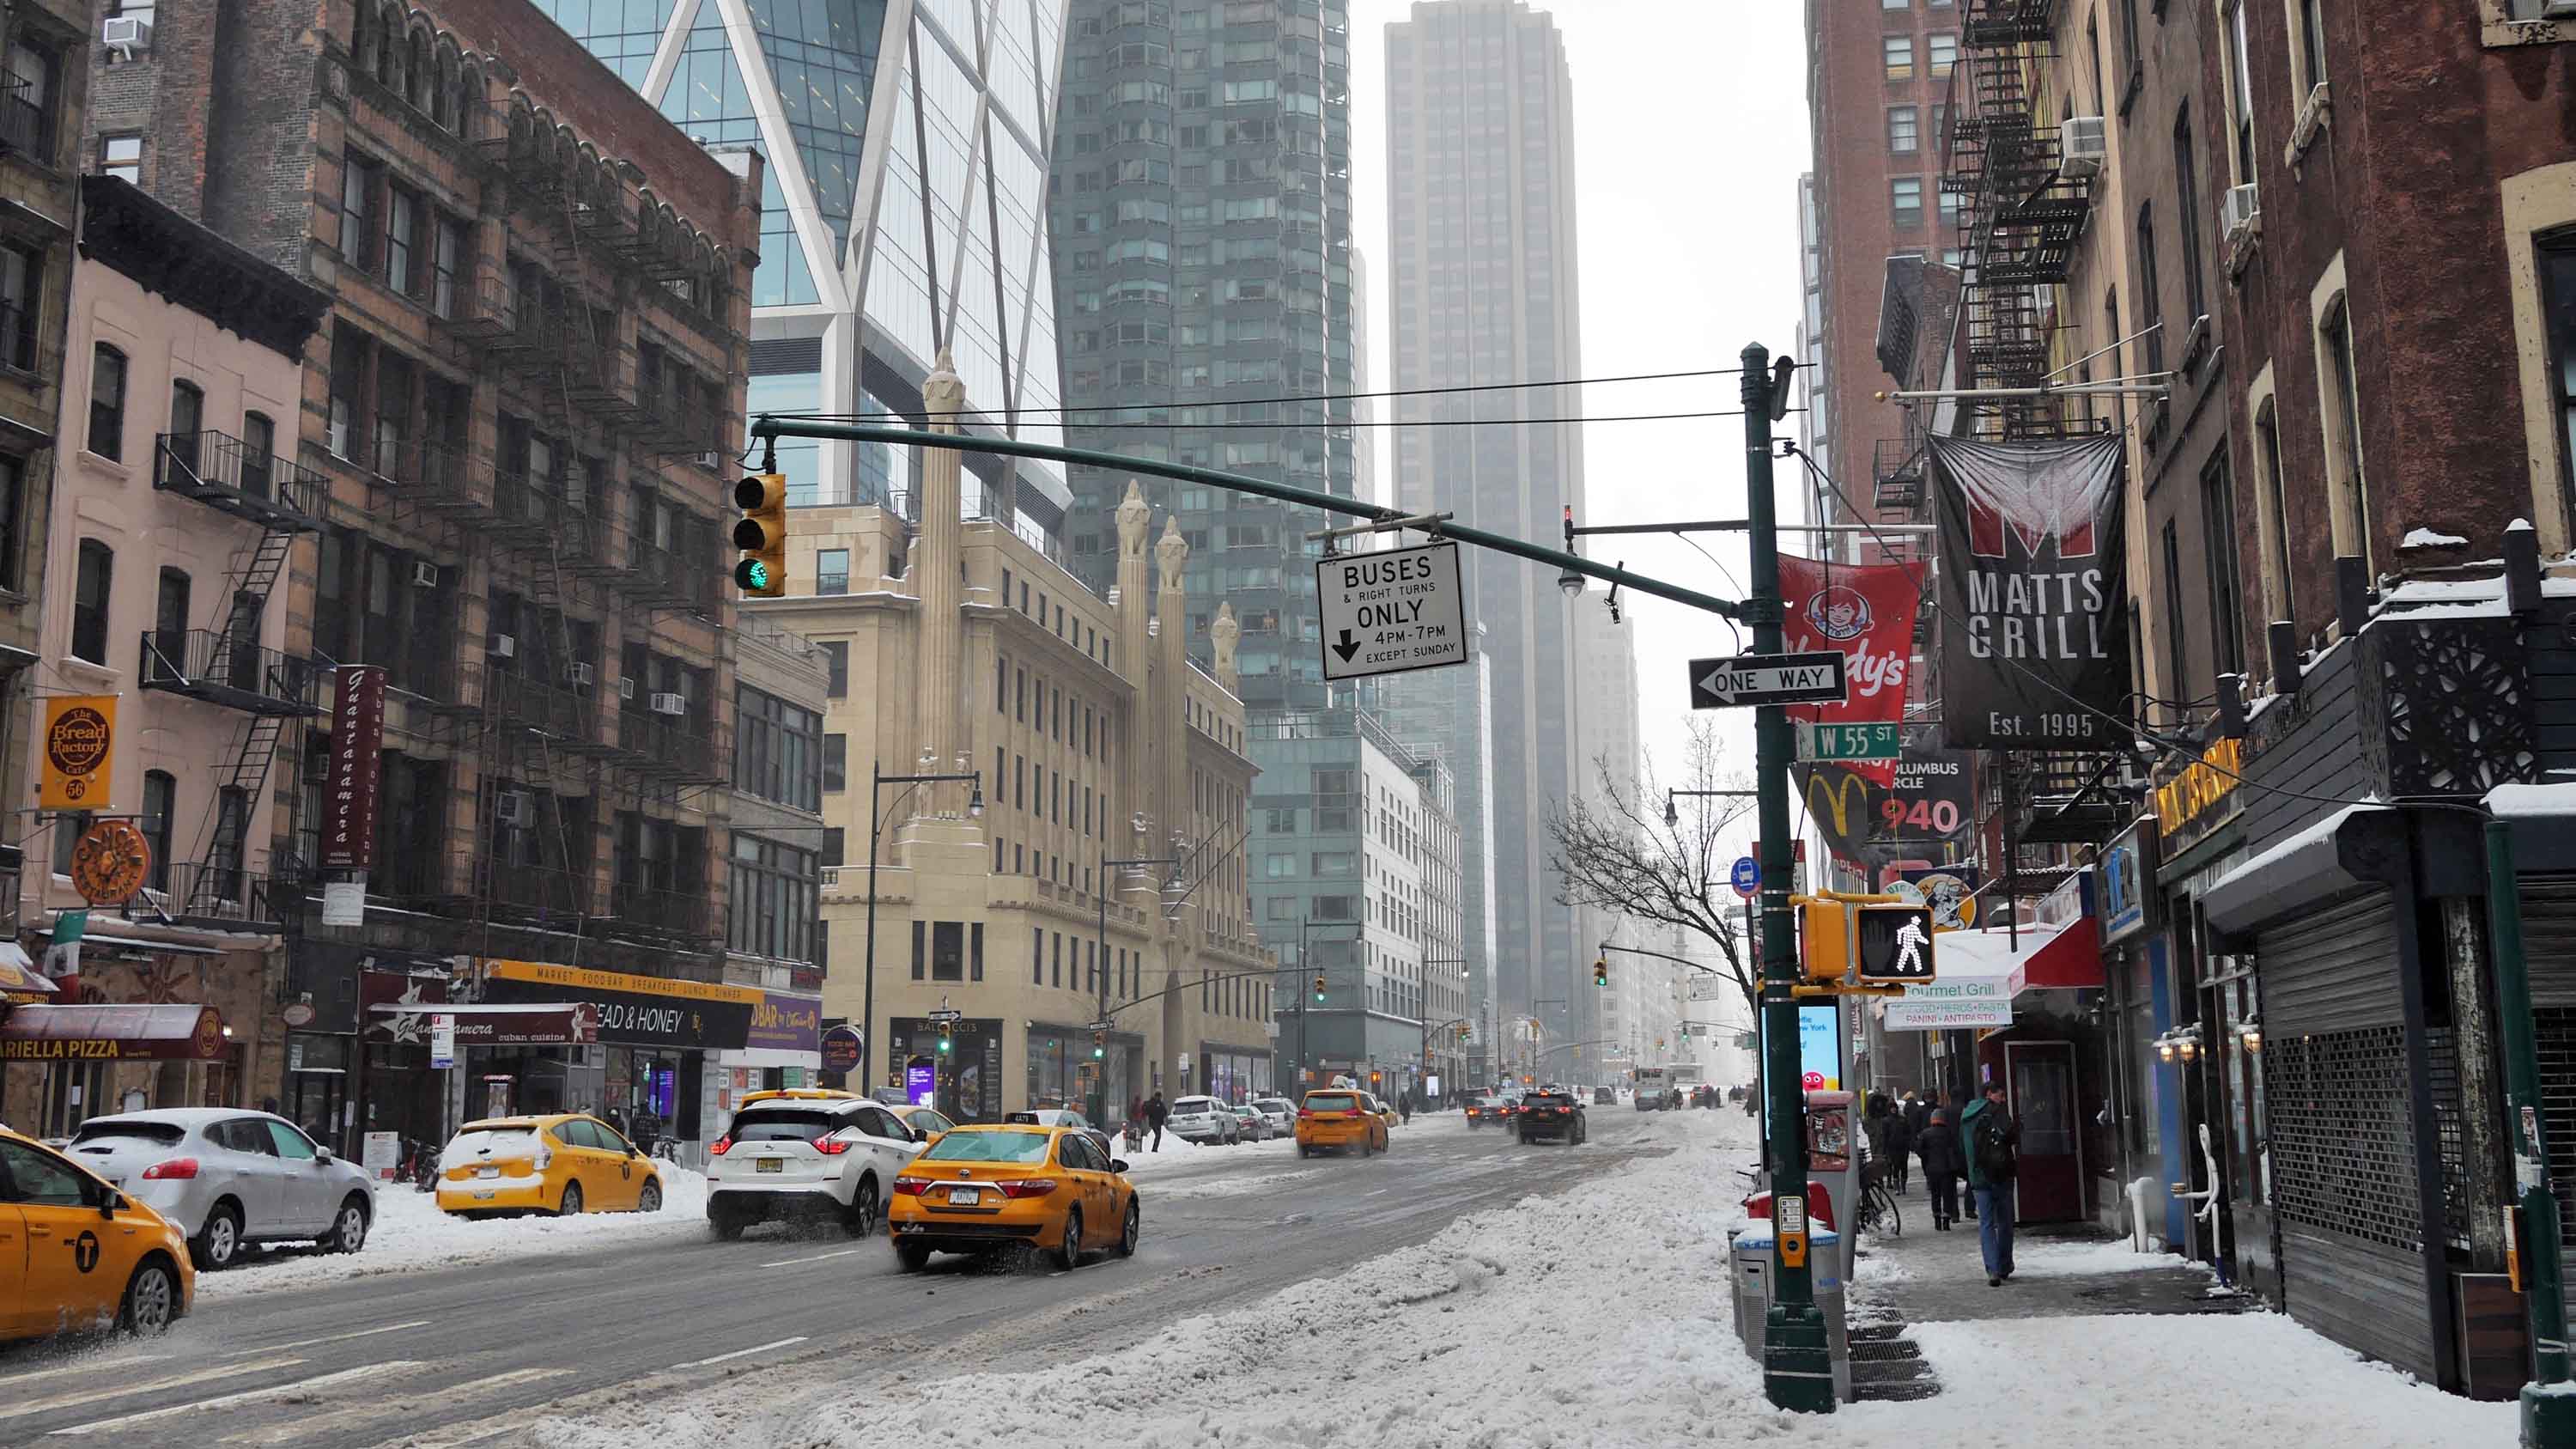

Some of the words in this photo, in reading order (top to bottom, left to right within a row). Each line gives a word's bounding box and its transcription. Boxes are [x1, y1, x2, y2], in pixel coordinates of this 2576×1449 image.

[1344, 556, 1431, 588] BUSES
[1344, 594, 1351, 603] &
[1359, 588, 1391, 601] RIGHT
[1399, 582, 1436, 595] TURNS
[1968, 569, 2103, 614] MATTS
[1358, 599, 1423, 628] ONLY
[1968, 615, 2108, 660] GRILL
[1366, 649, 1406, 663] EXCEPT
[1414, 642, 1456, 657] SUNDAY
[1715, 672, 1758, 692] ONE
[1779, 668, 1824, 688] WAY
[70, 709, 92, 718] The
[1990, 711, 2030, 735] Est.
[2040, 714, 2093, 737] 1995
[53, 724, 106, 740] Bread
[1820, 728, 1836, 755] W
[1845, 728, 1868, 755] 55
[1876, 727, 1893, 741] ST
[52, 740, 105, 754] Factory
[68, 782, 84, 797] 56
[1881, 800, 1959, 832] 940
[537, 968, 573, 982] MARKET
[1966, 983, 1995, 996] Grill
[398, 1017, 493, 1038] Guanamera
[625, 1009, 635, 1026] &
[636, 1004, 683, 1032] HONEY
[1905, 1014, 1937, 1024] PANINI
[1943, 1014, 1996, 1023] ANTIPASTO
[498, 1033, 527, 1042] cuban
[531, 1032, 565, 1042] cuisine
[68, 1040, 118, 1057] PIZZA
